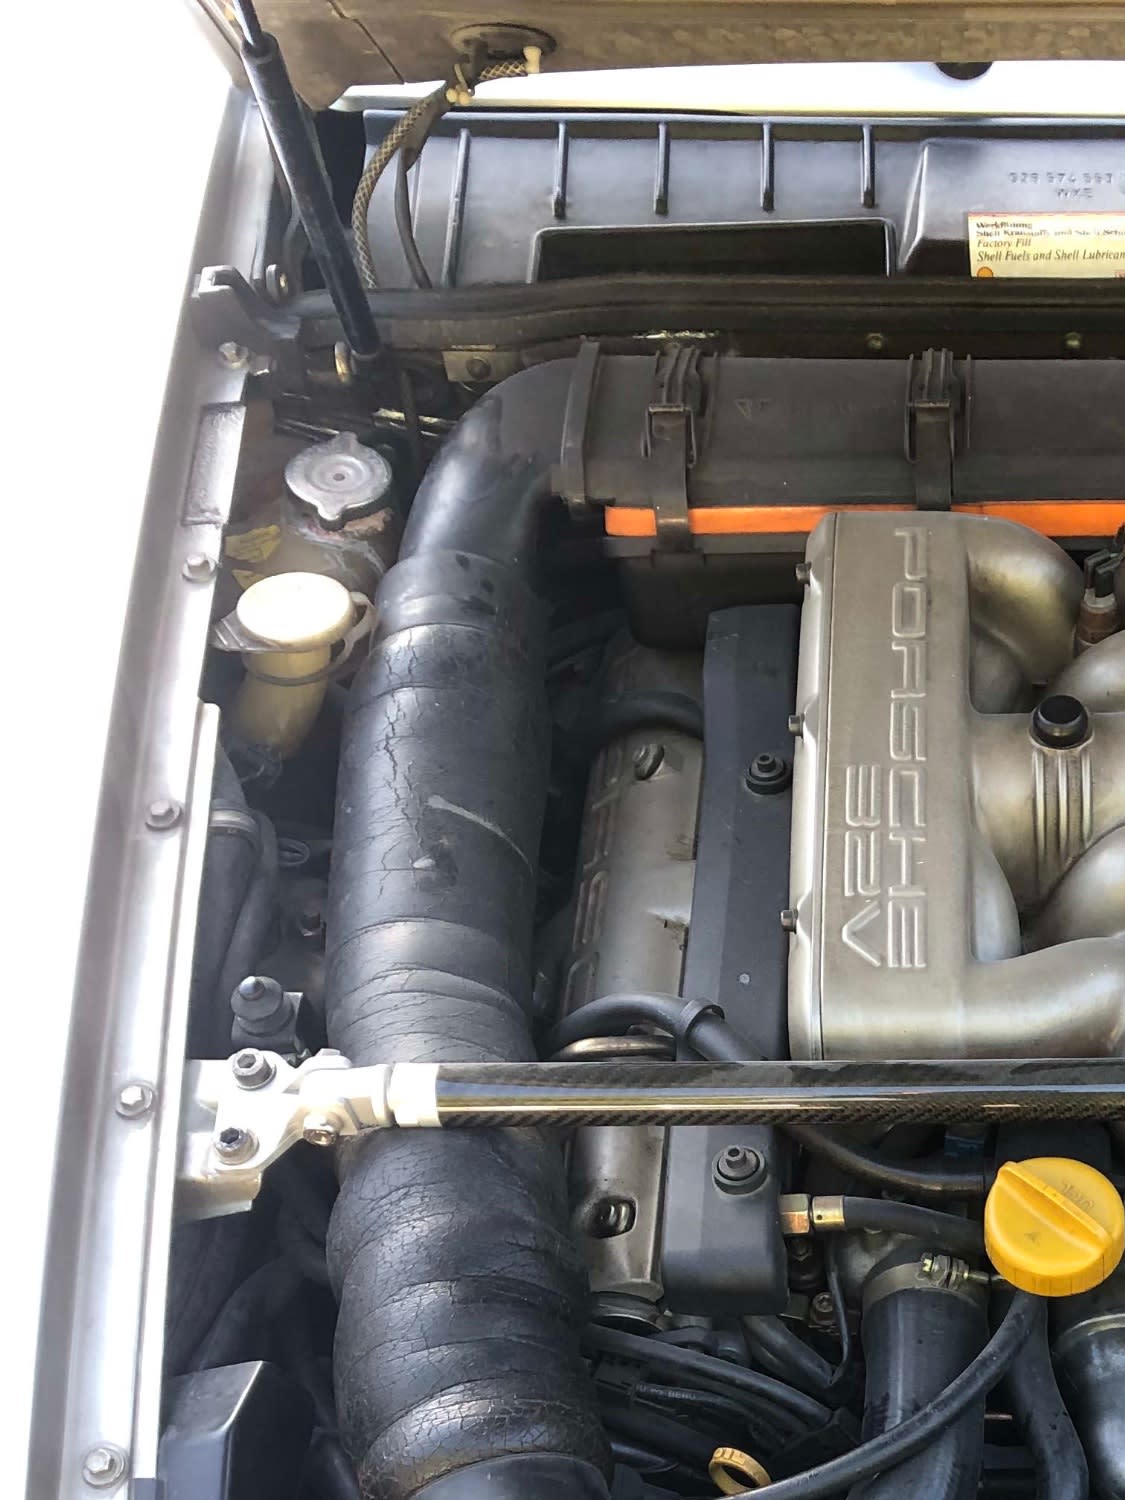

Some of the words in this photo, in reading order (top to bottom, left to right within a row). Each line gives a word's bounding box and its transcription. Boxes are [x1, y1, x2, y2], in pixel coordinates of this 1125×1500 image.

[977, 239, 1012, 249] Factory
[1016, 238, 1032, 248] Fill
[977, 250, 1002, 262] Shell
[1005, 250, 1031, 261] Fuels
[1033, 249, 1052, 261] and
[1054, 249, 1079, 261] Shell
[888, 527, 927, 968] PORSCHE
[842, 765, 882, 967] 32V
